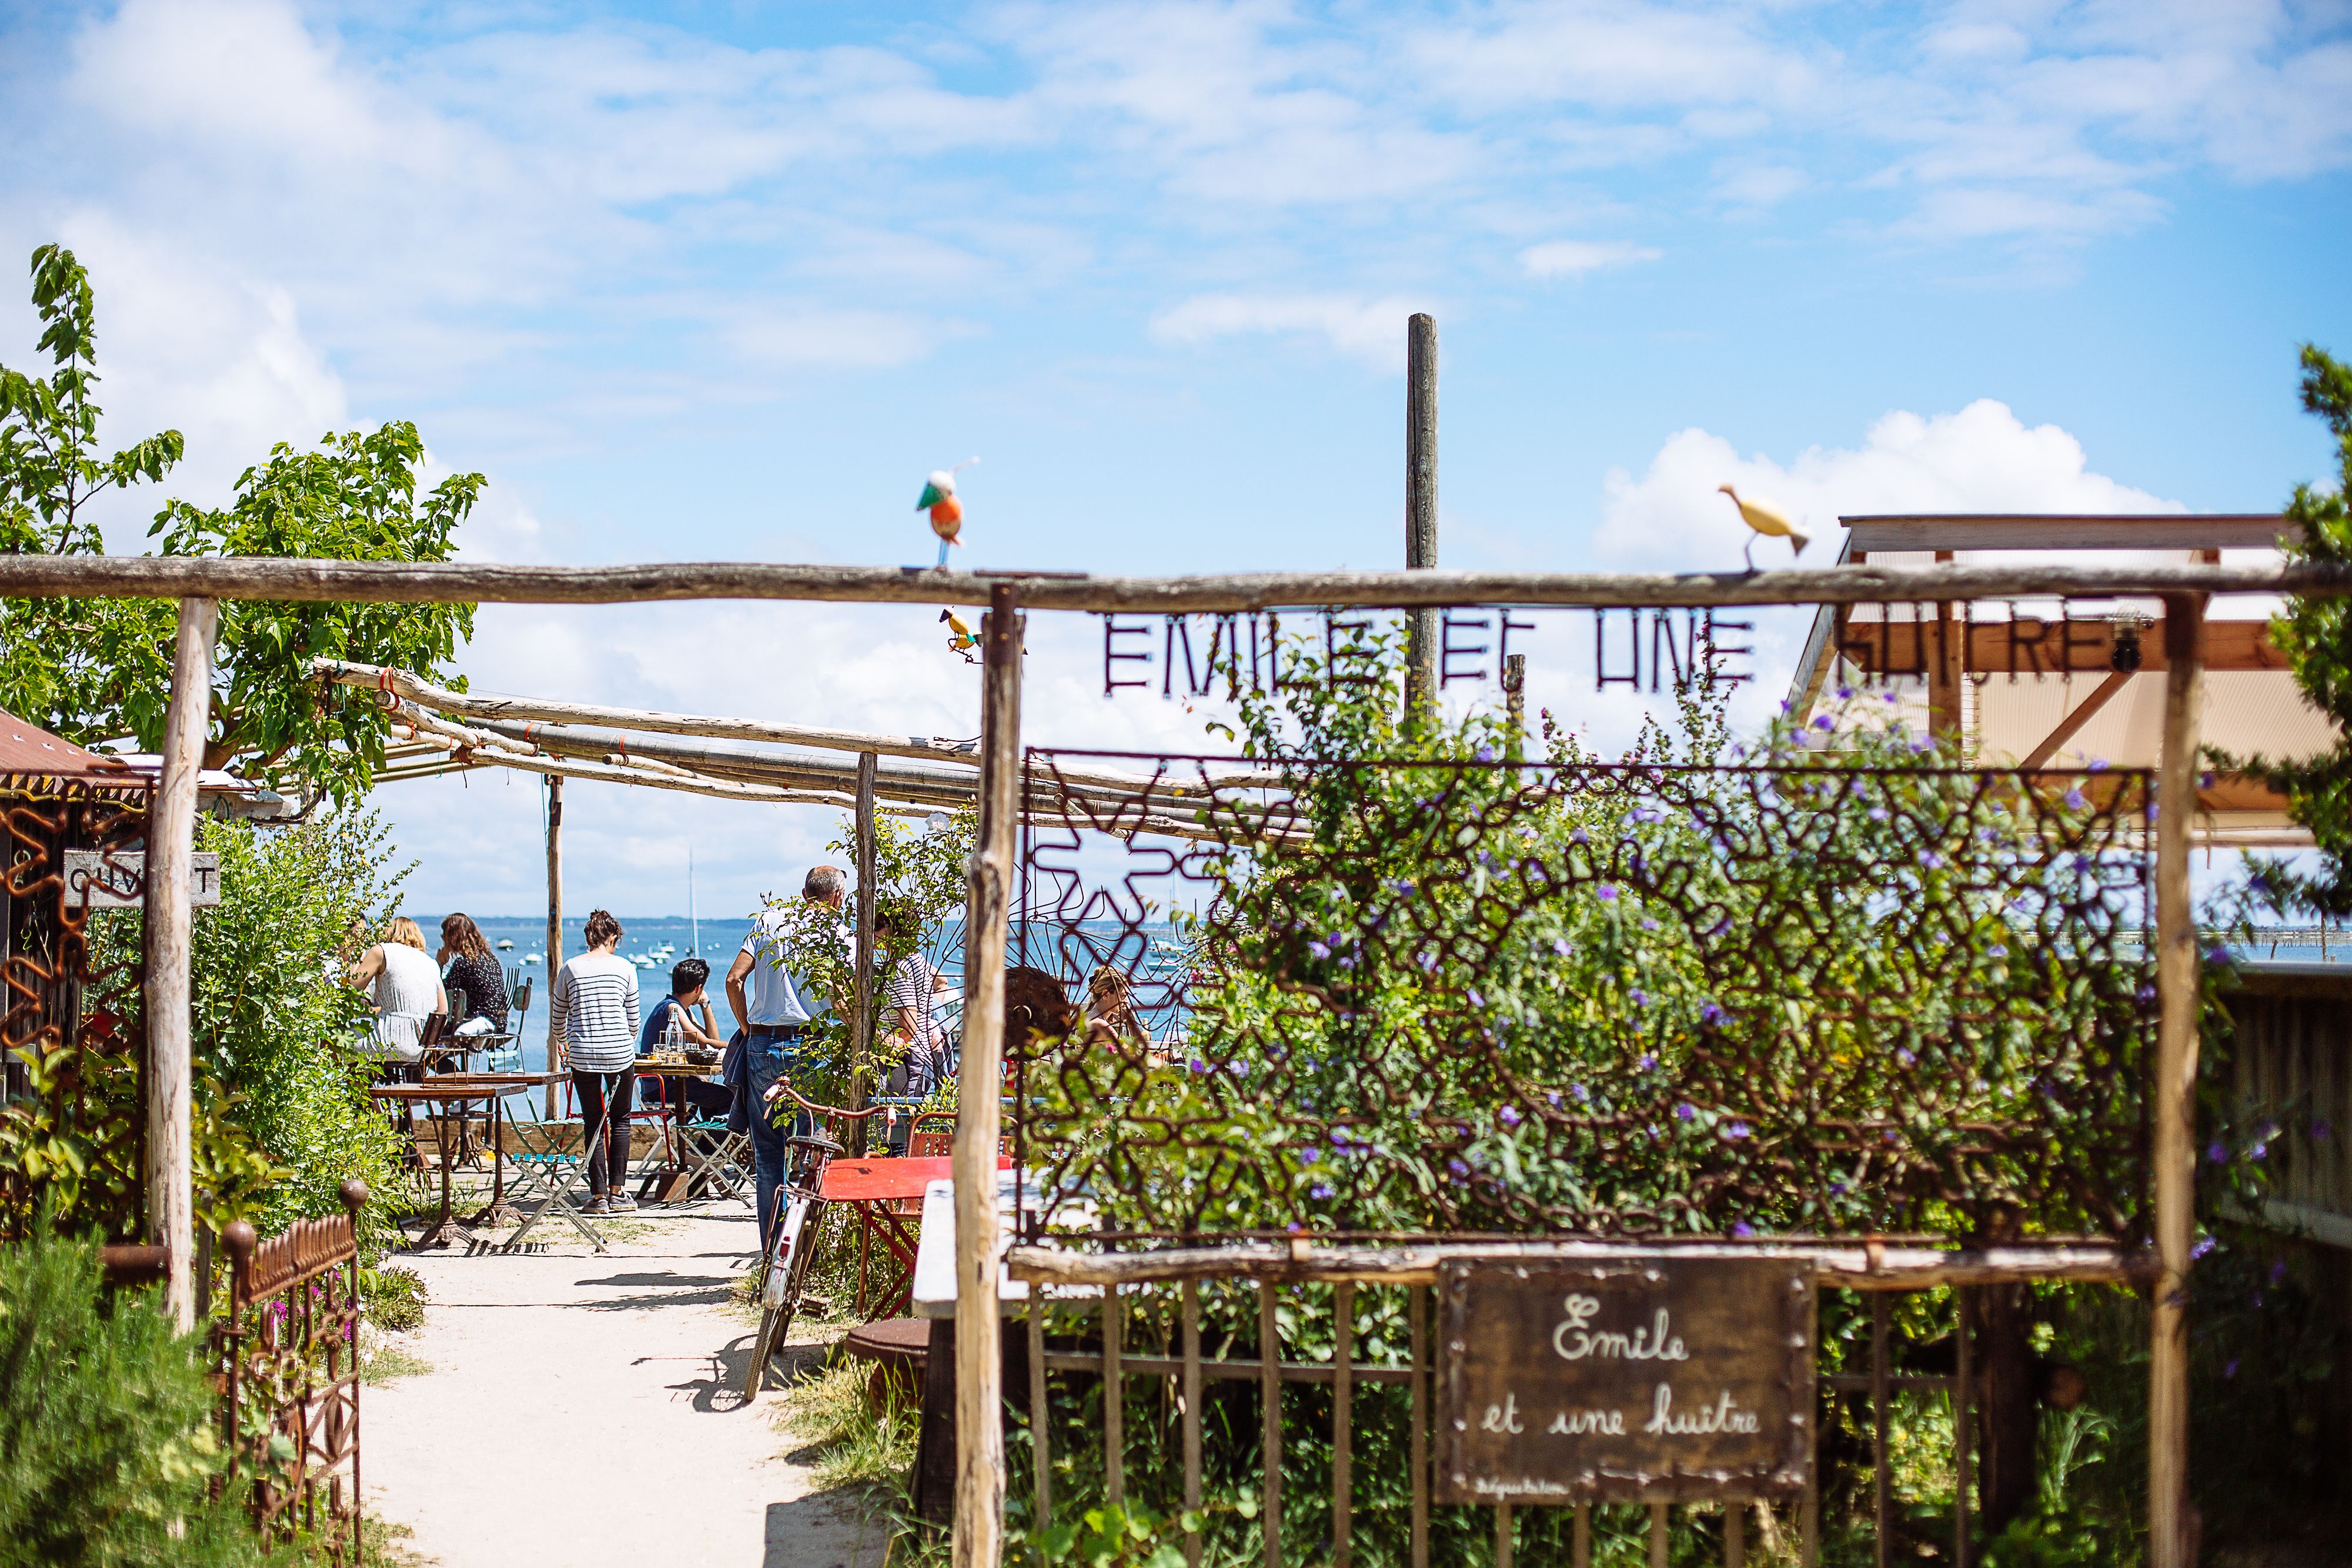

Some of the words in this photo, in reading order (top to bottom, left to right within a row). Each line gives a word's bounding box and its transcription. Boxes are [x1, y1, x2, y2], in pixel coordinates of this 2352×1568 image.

[1105, 613, 1379, 698] EMILE
[1595, 609, 1755, 694] UNE
[70, 868, 216, 893] OUVT
[1482, 1392, 1524, 1435] et
[1549, 1410, 1626, 1435] une
[1645, 1382, 1761, 1435] huître
